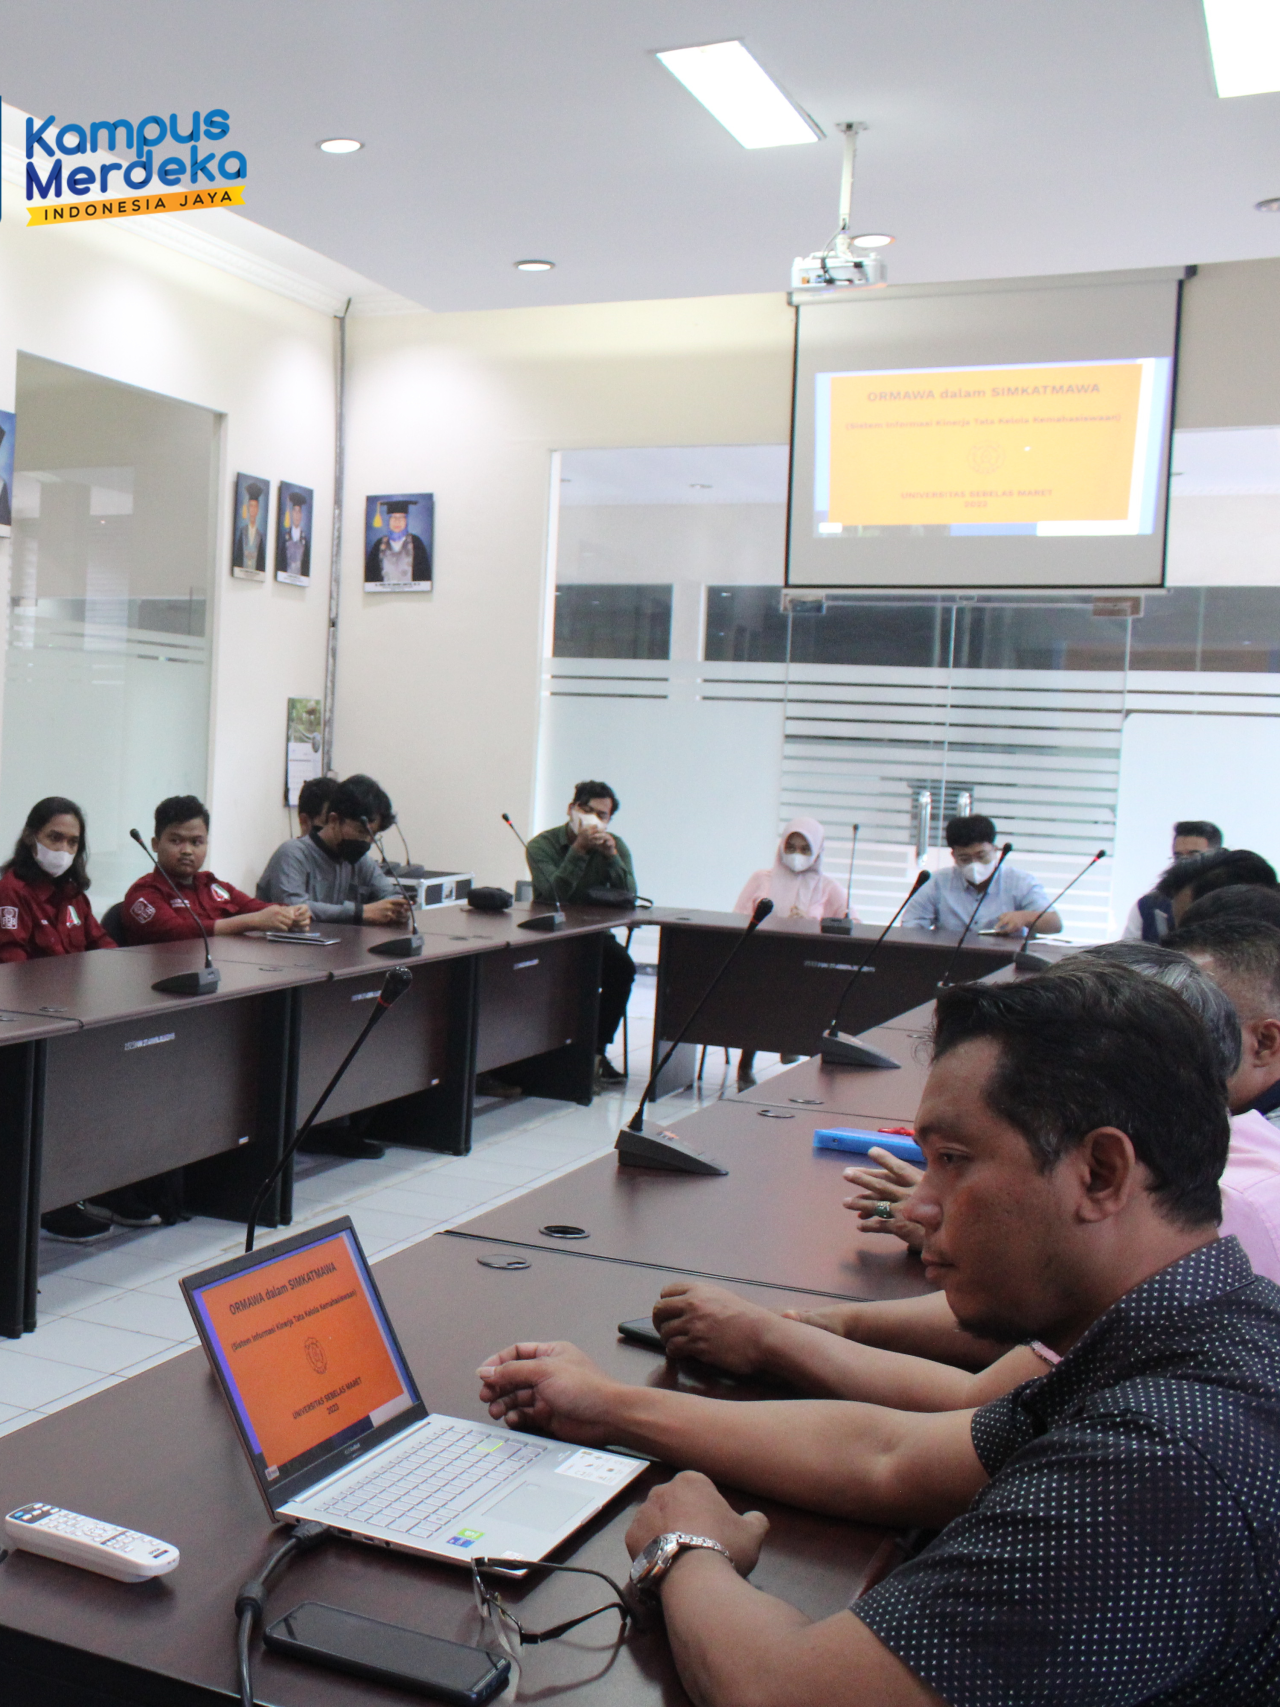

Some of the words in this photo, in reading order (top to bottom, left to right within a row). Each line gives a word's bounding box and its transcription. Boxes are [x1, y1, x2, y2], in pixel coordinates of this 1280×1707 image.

[867, 390, 936, 402] ORMAWA
[940, 387, 987, 399] dalam
[991, 383, 1101, 397] SIMKATMAWA
[969, 489, 1015, 498] SEBELAS
[1017, 488, 1053, 497] MARET
[229, 1292, 265, 1315] ORMAWA
[265, 1285, 288, 1301] dalam
[288, 1262, 337, 1290] SIMKATMAWA
[292, 1397, 325, 1420] UNIVERSITAS
[324, 1386, 347, 1402] SEBELAS
[346, 1376, 362, 1390] MARET
